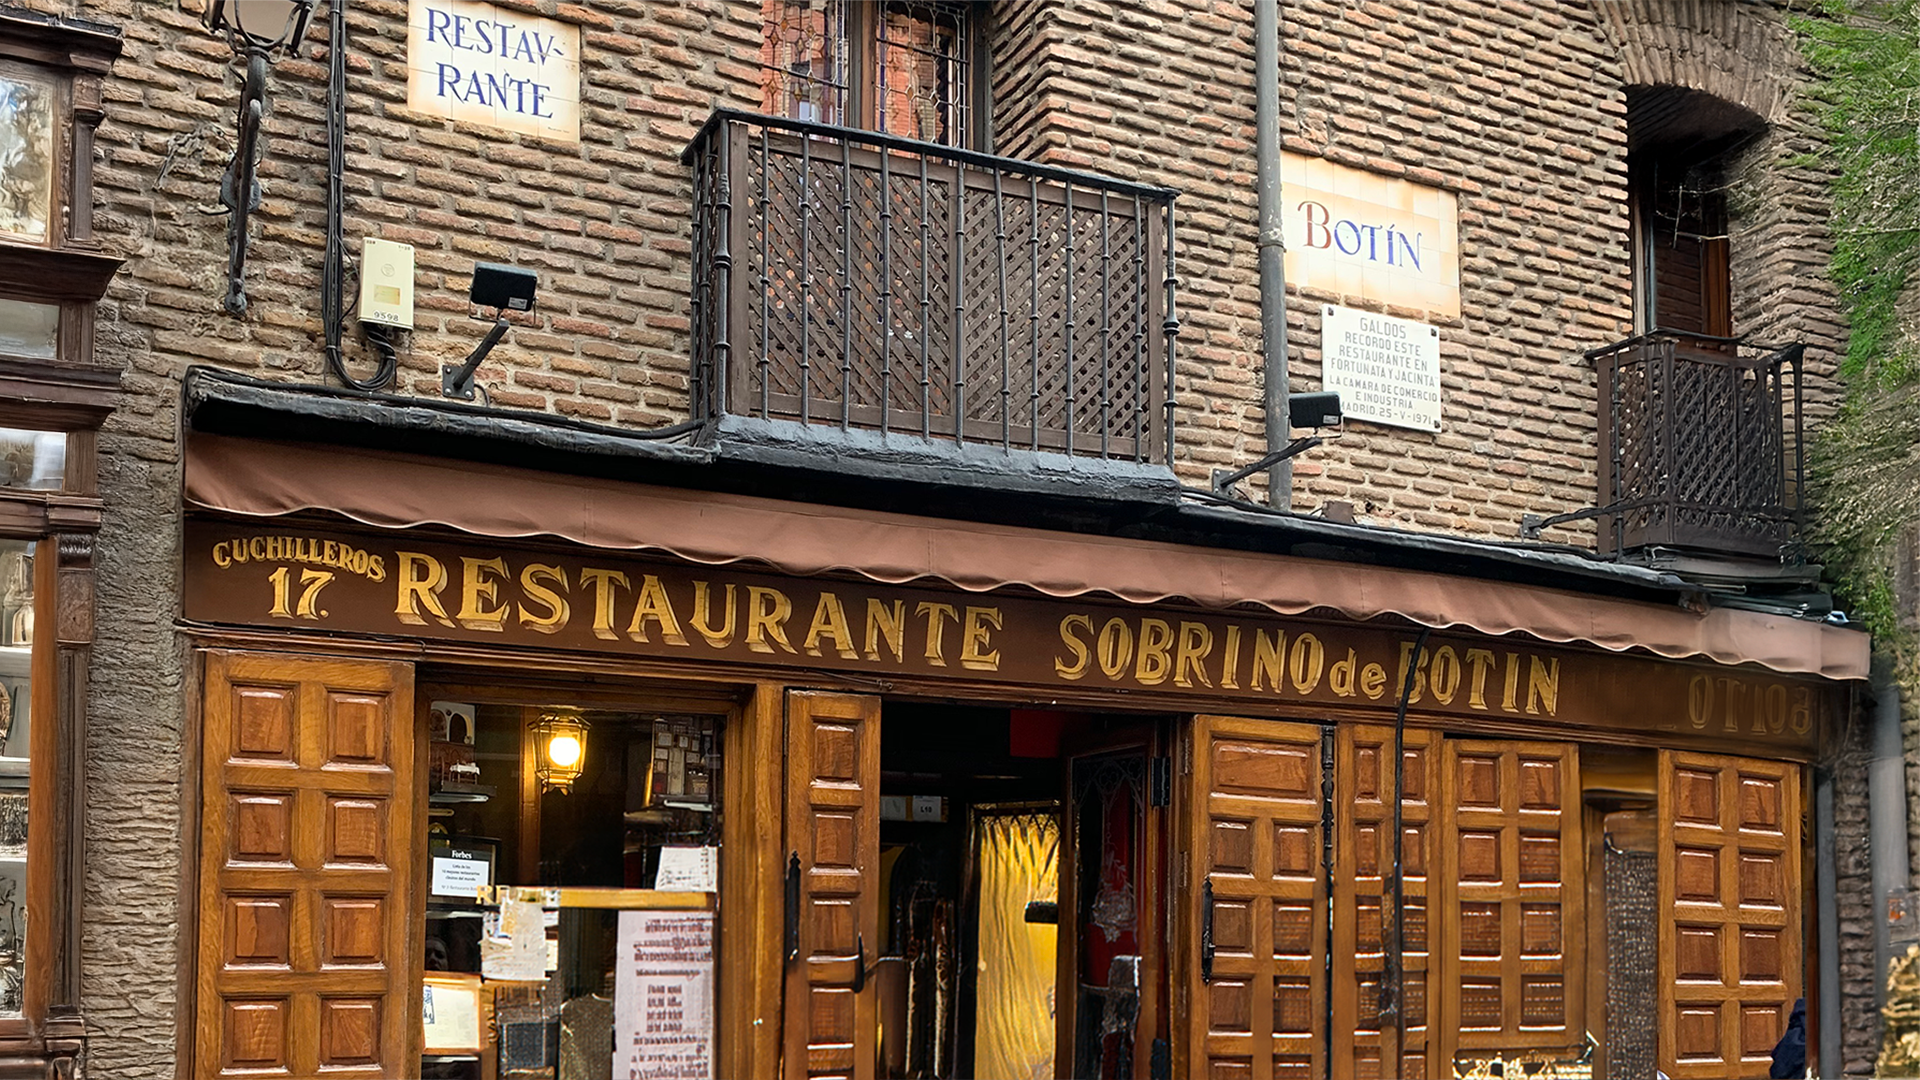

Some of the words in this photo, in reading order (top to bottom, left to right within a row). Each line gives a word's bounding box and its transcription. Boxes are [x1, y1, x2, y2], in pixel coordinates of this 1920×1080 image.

[436, 61, 553, 118] RANTE
[1297, 200, 1423, 273] BOTÍN
[374, 311, 399, 322] 9598
[1339, 345, 1411, 369] RESTAURANTE
[1414, 360, 1428, 372] EN
[1394, 341, 1421, 357] ESTE
[1388, 369, 1394, 380] Y
[1329, 375, 1341, 386] LA
[1381, 384, 1392, 395] DE
[1394, 385, 1438, 402] COMERCIO
[1355, 391, 1362, 401] E
[212, 535, 387, 583] CUCHILLEROS
[394, 551, 1003, 672] RESTAURANTE
[1054, 614, 1324, 695] SOBRINO
[1329, 647, 1388, 700] de
[1397, 640, 1560, 717] BOTIN
[451, 849, 473, 859] Forbes
